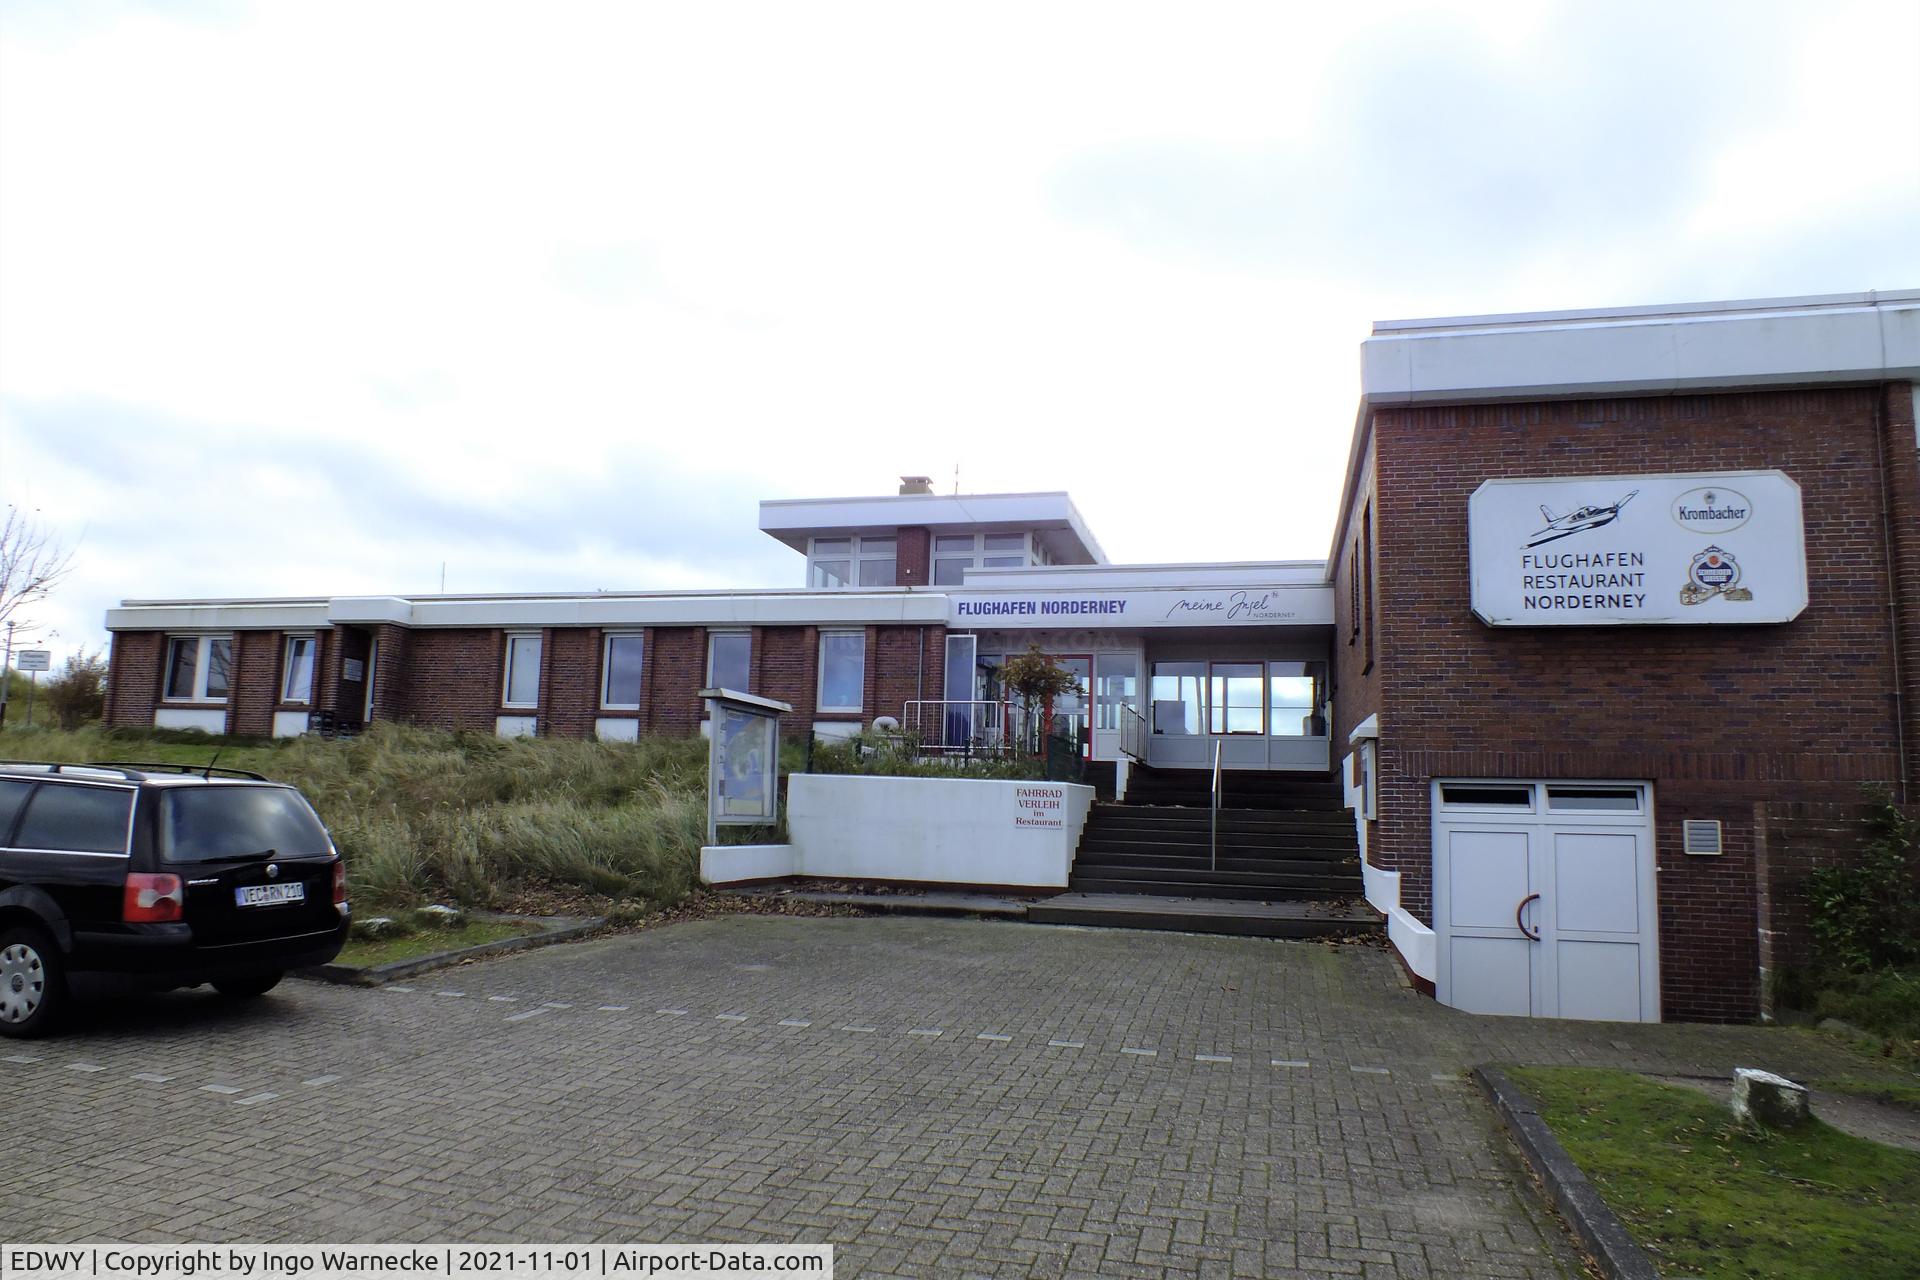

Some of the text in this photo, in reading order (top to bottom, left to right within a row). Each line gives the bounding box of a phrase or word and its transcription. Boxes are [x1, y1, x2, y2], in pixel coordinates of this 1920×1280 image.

[1679, 506, 1746, 520] Krombacher
[1522, 553, 1643, 568] FLUGHAFEN
[1523, 573, 1645, 589] RESTAURANT
[958, 600, 1127, 615] FLUGHAFEN NORDERNEY
[1166, 599, 1225, 618] meine
[1524, 594, 1646, 609] NORDERNEY
[1016, 788, 1062, 798] FAHRRAD
[1019, 800, 1060, 809] VERLEIH
[1016, 817, 1062, 826] Restaurant
[243, 887, 262, 903] VEC
[270, 886, 283, 900] RN
